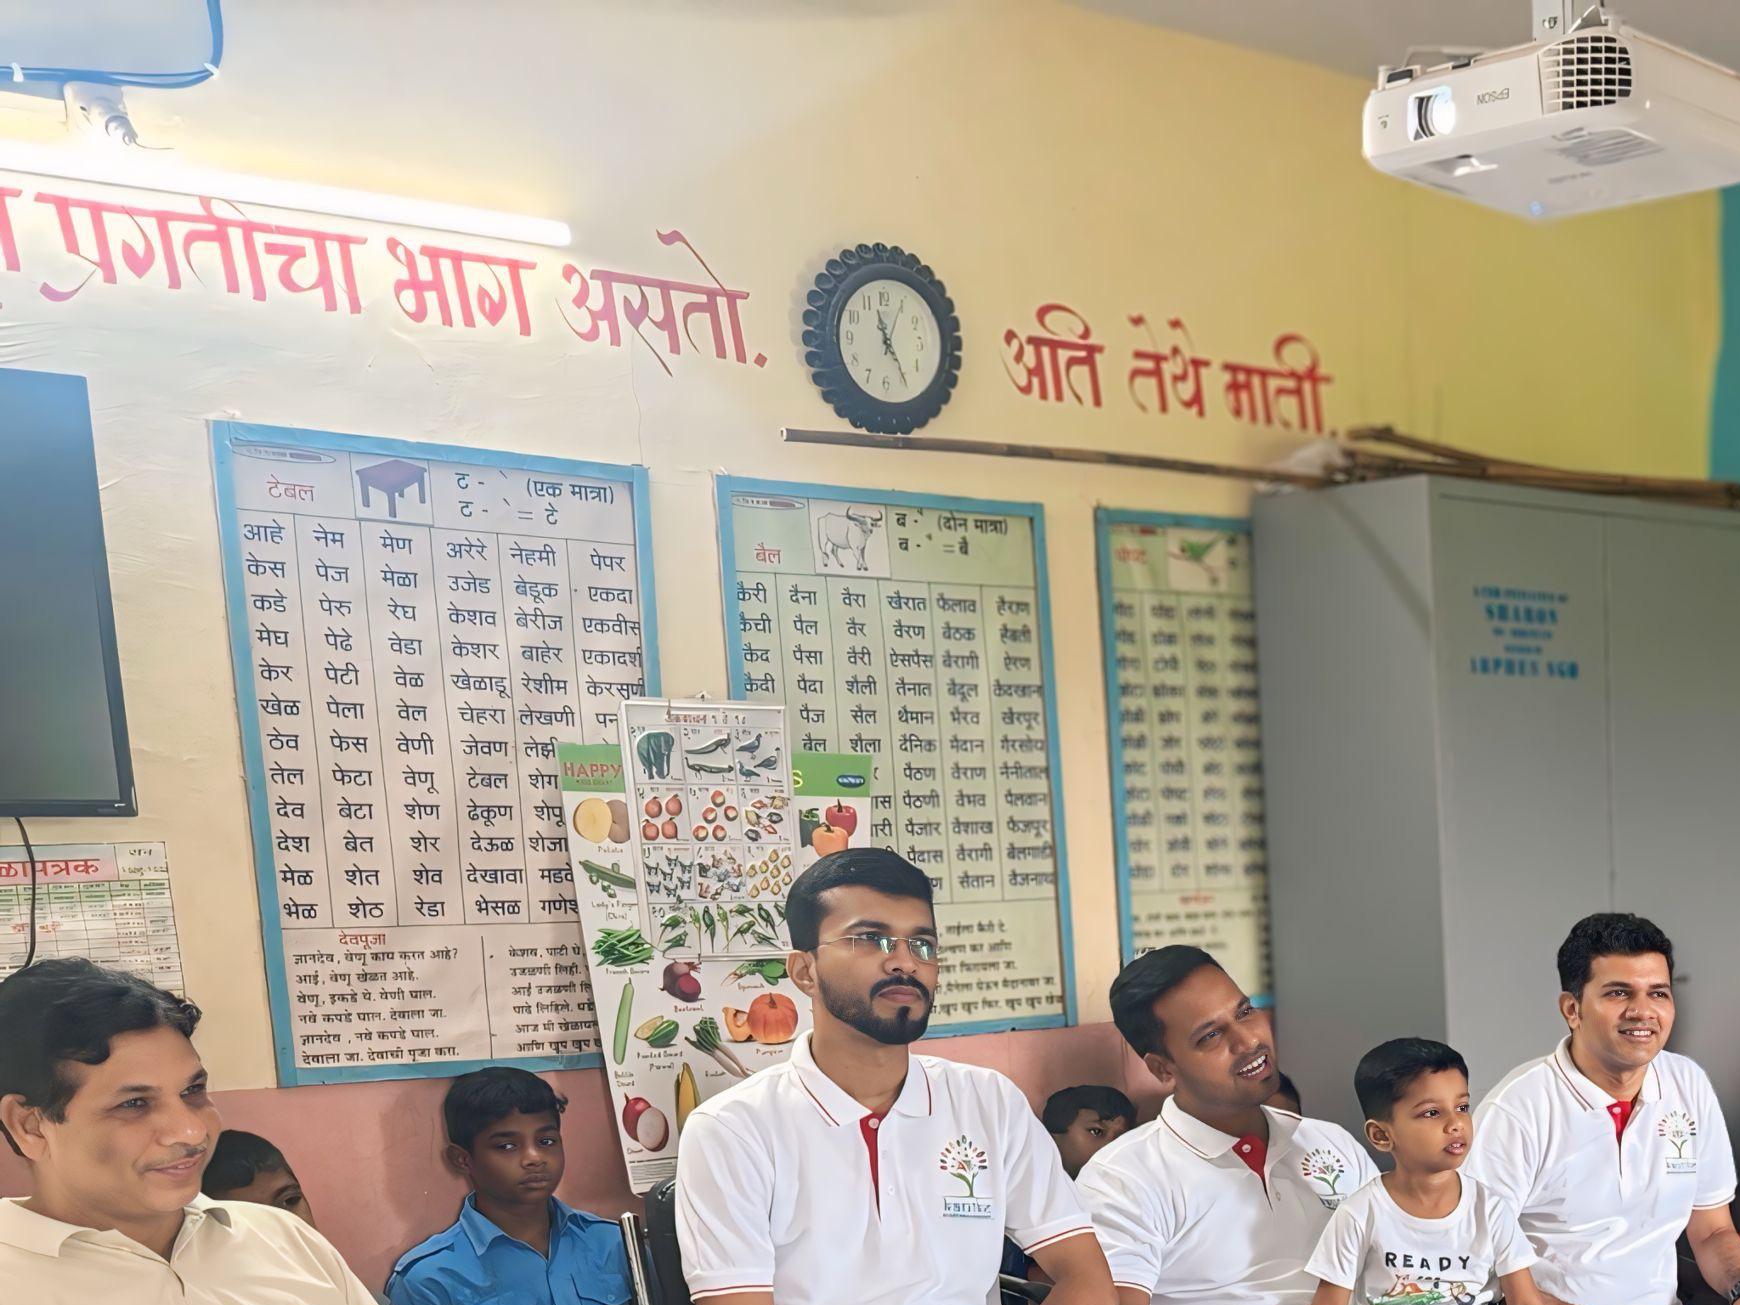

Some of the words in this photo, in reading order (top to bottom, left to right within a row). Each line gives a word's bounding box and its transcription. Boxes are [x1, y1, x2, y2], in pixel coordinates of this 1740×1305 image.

[386, 236, 537, 337] भाग
[1001, 303, 1105, 408] अति
[1128, 313, 1211, 417] तेथे
[266, 473, 315, 502] टेबल
[243, 518, 285, 545] आहे
[312, 522, 345, 549] नेम
[379, 529, 413, 555] मेण
[446, 537, 488, 561] अरेरे
[509, 541, 557, 567] नेहमी
[590, 548, 626, 571] पेपर
[754, 541, 781, 566] बैल
[246, 552, 287, 578] केस
[314, 558, 350, 584] पेज
[380, 563, 418, 589] मेळा
[447, 570, 491, 594] उजेड
[513, 574, 559, 604] बेडूक
[587, 586, 633, 605] एकदा
[251, 588, 288, 613] कडे
[387, 597, 417, 622] रेघ
[447, 602, 497, 628] केशव
[514, 606, 563, 632] बेरीज
[255, 622, 290, 648] मेघ
[387, 631, 423, 656] वेडा
[450, 634, 500, 660] केशर
[520, 640, 564, 664] बाहेर
[258, 657, 293, 682] केर
[324, 661, 360, 685] पेटी
[393, 665, 425, 688] वेळ
[450, 668, 511, 699] खेळाडू
[521, 671, 568, 696] रेशीम
[258, 692, 301, 717] खेळ
[326, 694, 365, 719] पेला
[395, 698, 428, 722] वेल
[457, 701, 506, 725] चेहरा
[518, 703, 576, 728] लेखणी
[266, 726, 299, 751] ठेव
[329, 729, 368, 754] फेस
[395, 731, 434, 756] वेणी
[460, 733, 509, 758] जेवण
[268, 761, 305, 786] तेल
[331, 762, 373, 787] फेटा
[402, 764, 440, 795] वेणू
[466, 766, 509, 790] टेबल
[563, 760, 623, 779] HAPPY
[275, 795, 306, 820] देव
[336, 796, 374, 820] बेटा
[403, 797, 441, 821] शेण
[275, 828, 310, 853] देश
[343, 829, 374, 853] बेत
[409, 829, 441, 853] शेर
[279, 862, 315, 887] मेळ
[344, 862, 380, 887] शेत
[412, 862, 444, 886] शेव
[465, 862, 525, 885] देखावा
[283, 896, 319, 921] भेळ
[347, 896, 385, 919] शेठ
[414, 895, 446, 918] रेडा
[474, 893, 522, 917] भेसळ
[1385, 1251, 1470, 1272] READY
